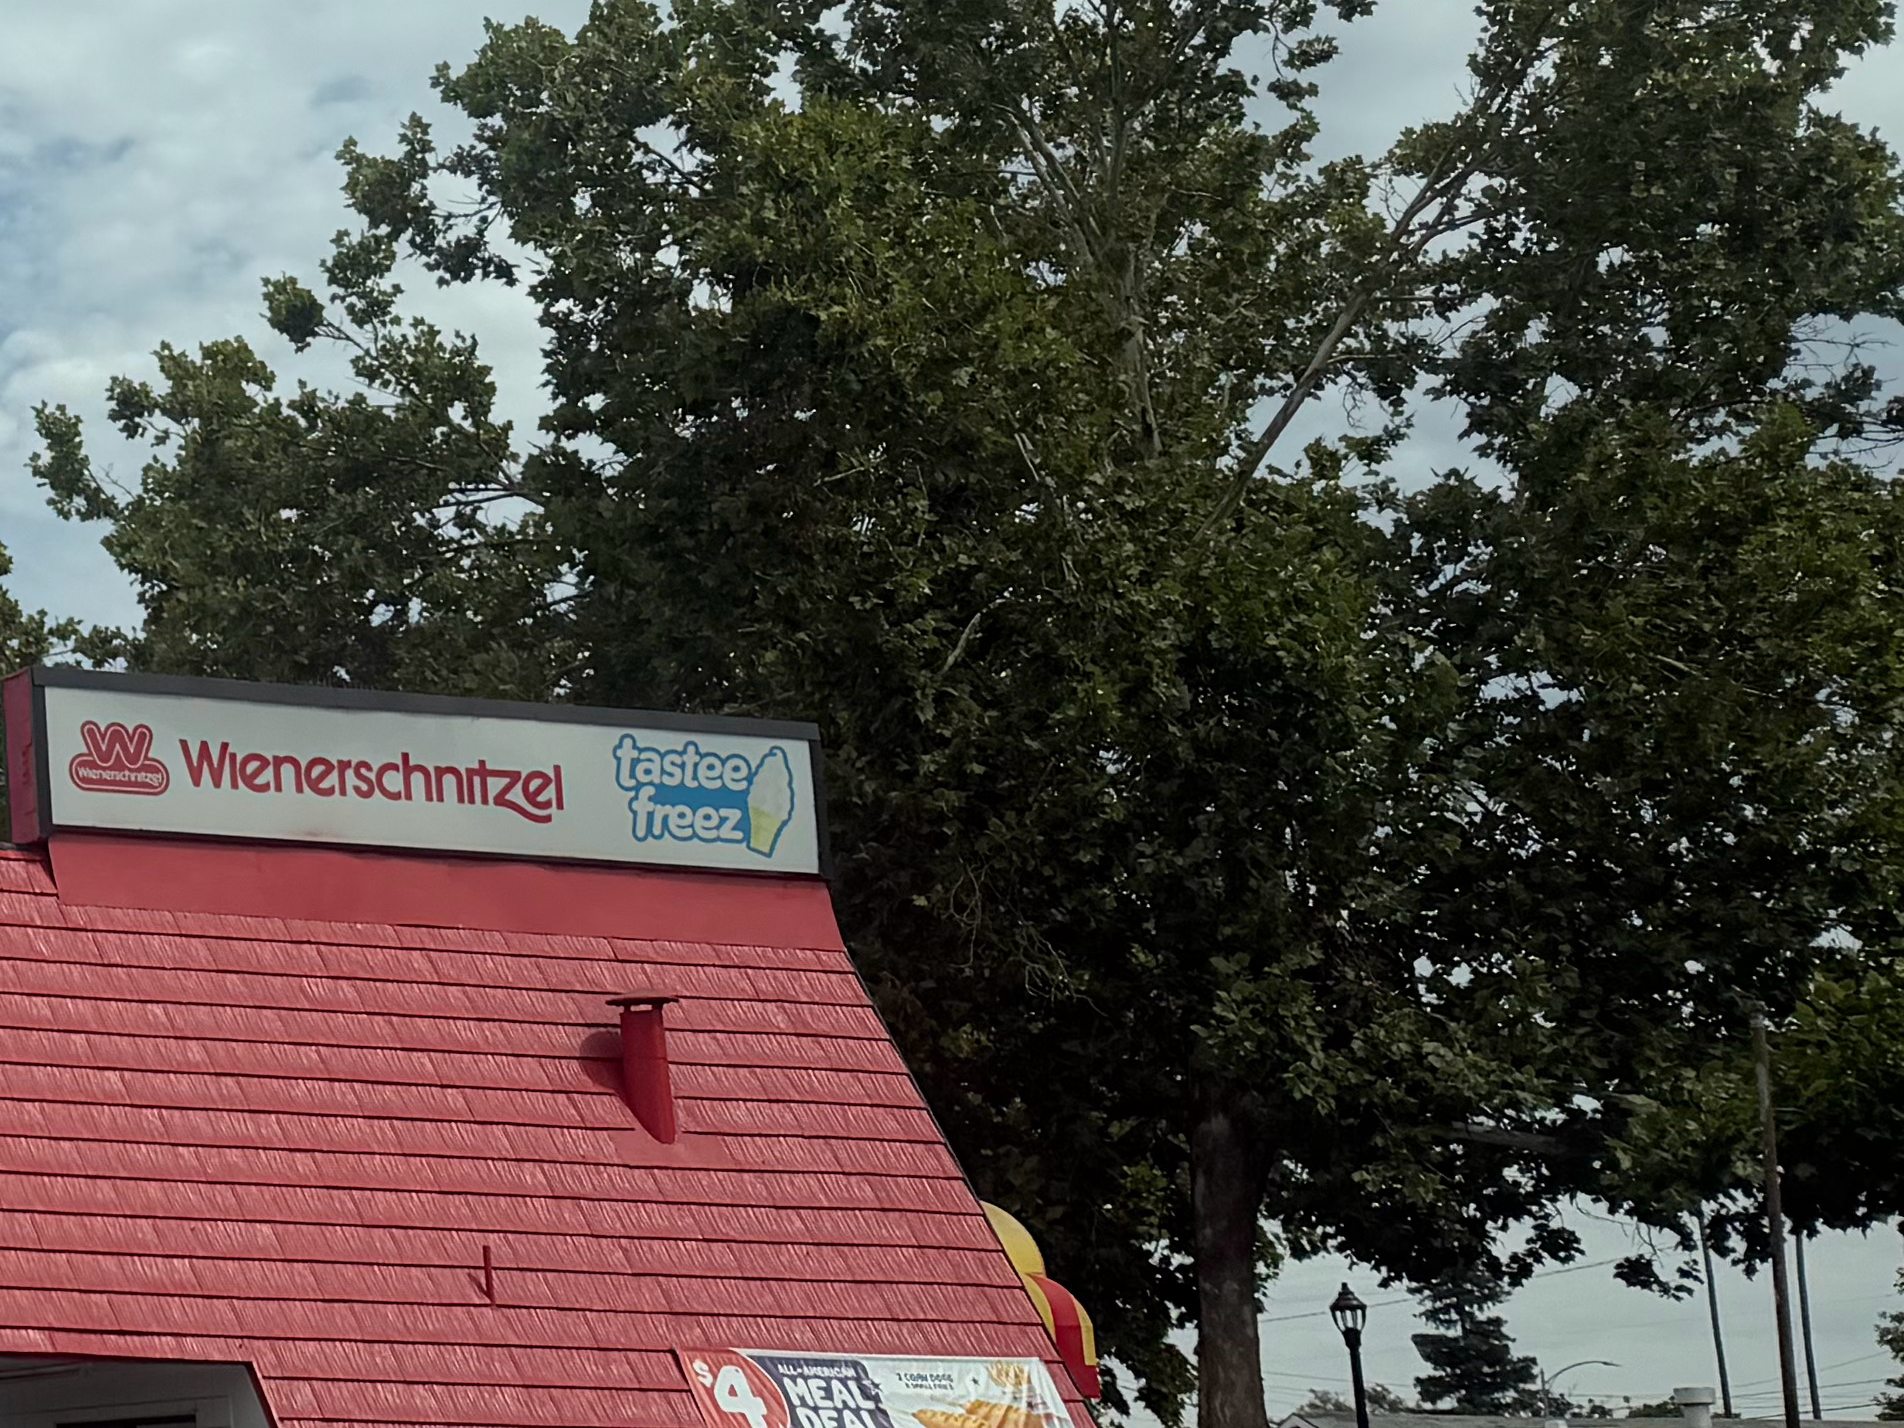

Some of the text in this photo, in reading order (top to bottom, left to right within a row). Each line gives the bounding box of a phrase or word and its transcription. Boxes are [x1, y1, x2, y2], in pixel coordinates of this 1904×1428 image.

[178, 738, 565, 824] Wienerschnitzel
[615, 735, 750, 791] tastee
[630, 784, 745, 842] freez
[782, 1376, 876, 1410] MEAL
